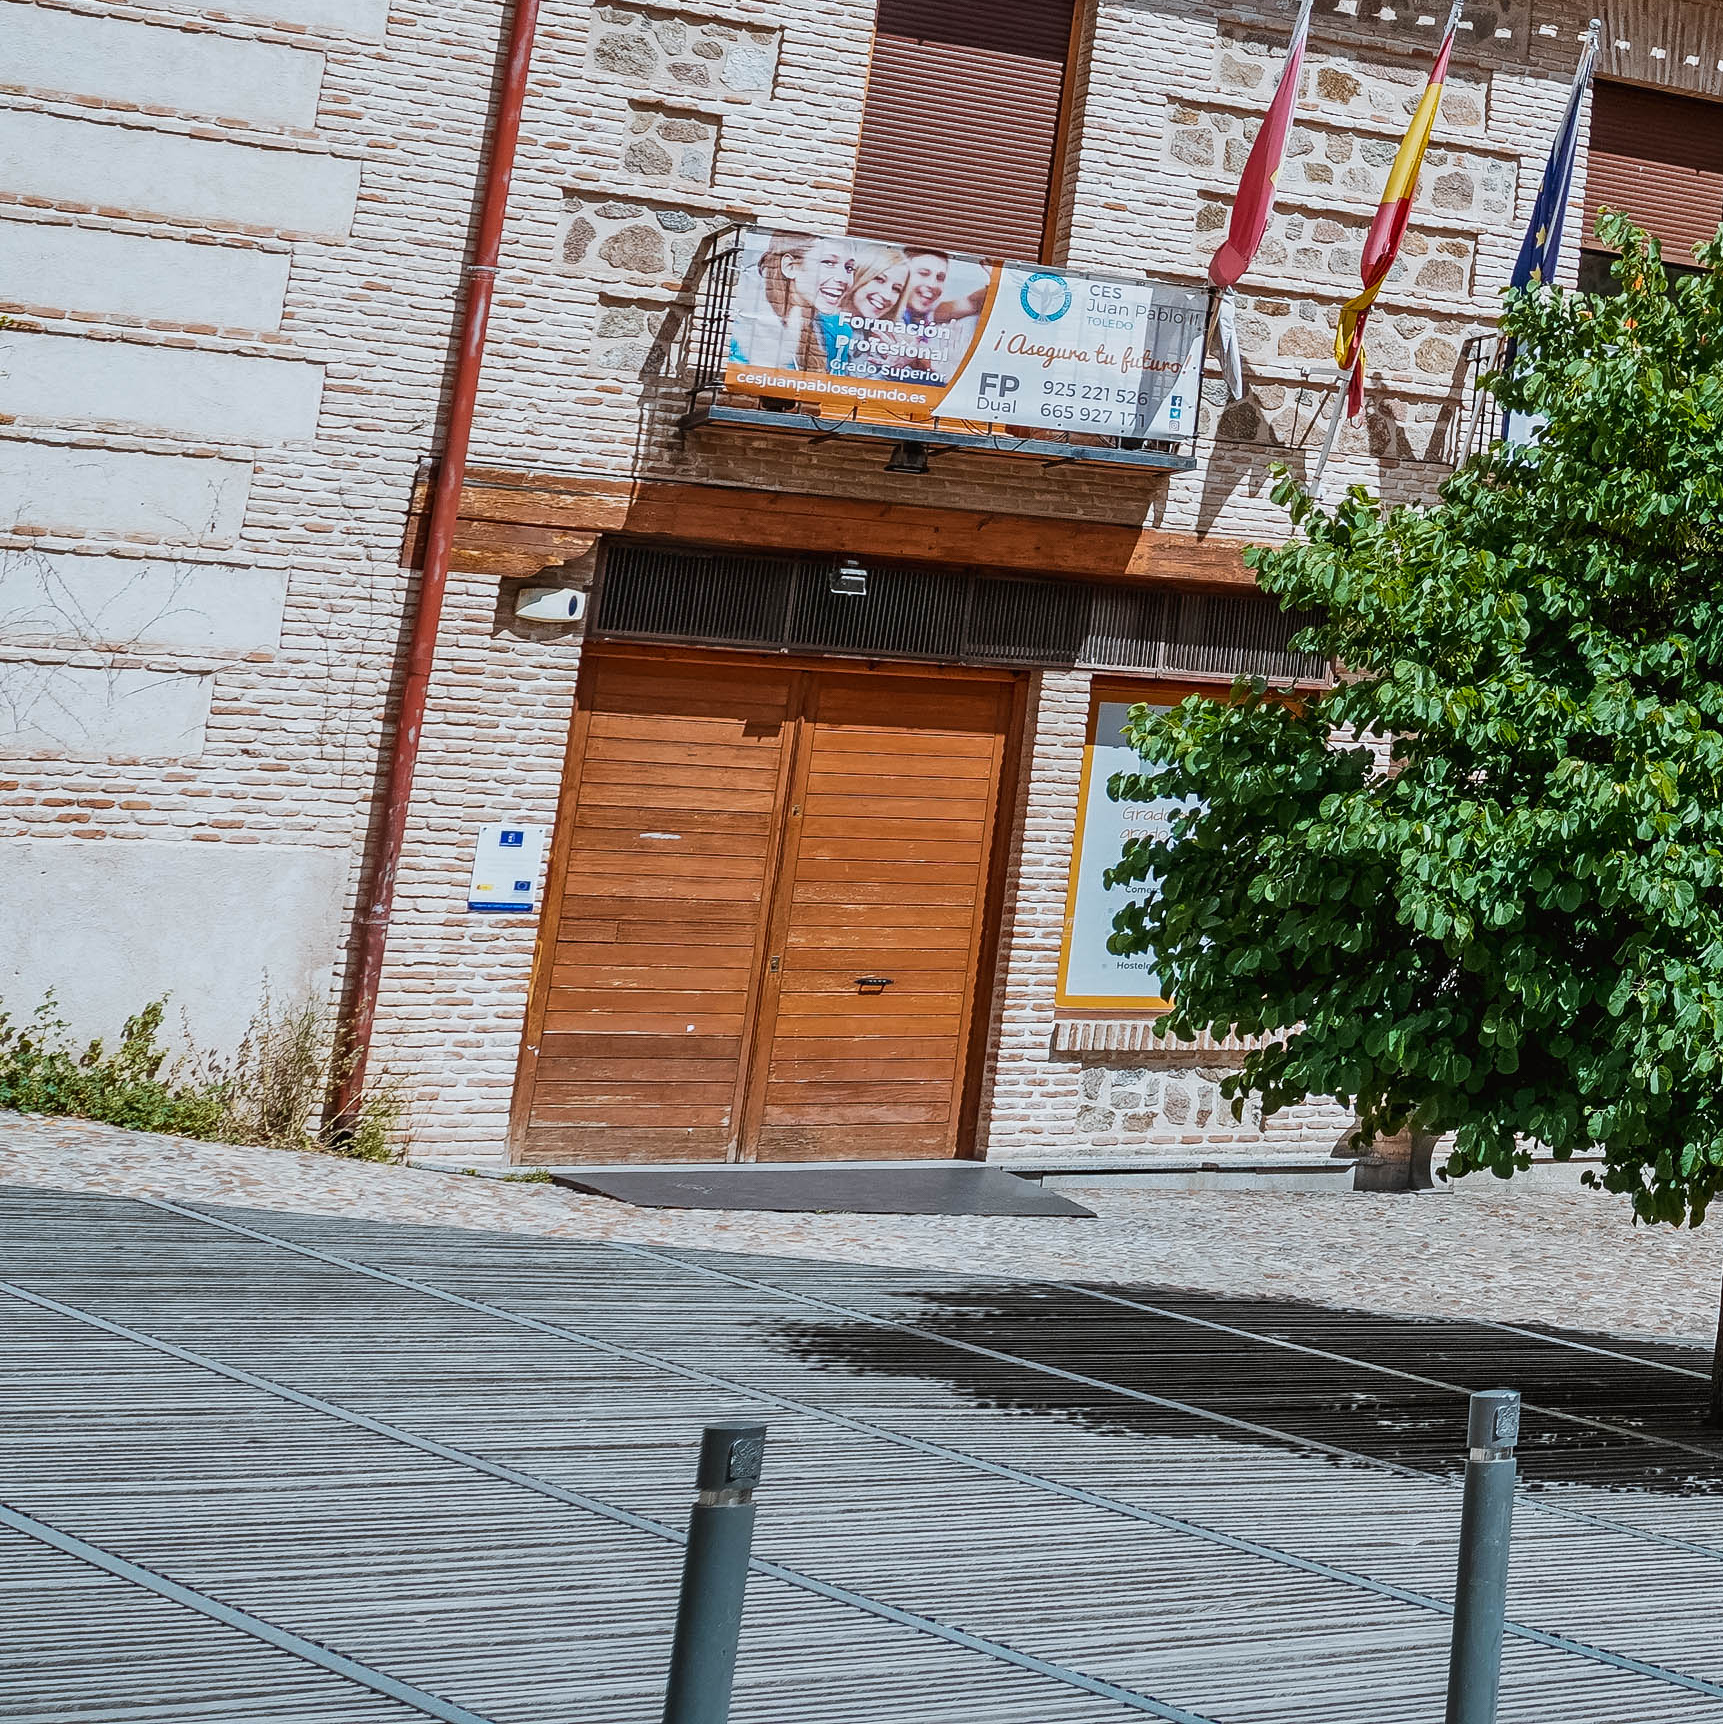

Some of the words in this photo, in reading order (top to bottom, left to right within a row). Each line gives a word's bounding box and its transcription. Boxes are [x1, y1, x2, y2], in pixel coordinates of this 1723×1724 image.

[1089, 284, 1123, 300] CES
[1086, 298, 1130, 318] Juan
[1135, 304, 1184, 324] Pablo
[1188, 313, 1200, 326] II
[1086, 316, 1134, 331] TOLEDO
[838, 311, 951, 340] Formación
[835, 334, 949, 363] Profesional
[1096, 344, 1117, 366] tu
[1121, 346, 1192, 375] futuro!
[829, 359, 878, 375] Grado
[880, 365, 947, 385] Superior
[978, 372, 1020, 398] FP
[736, 372, 927, 405] cesjuanpablosegundo.es
[1042, 381, 1077, 398] 925
[1081, 385, 1110, 402] 221
[1115, 389, 1149, 406] 526
[976, 396, 1017, 414] Dual
[1040, 403, 1074, 420] 665
[1079, 407, 1113, 424] 927
[1119, 411, 1145, 429] 171
